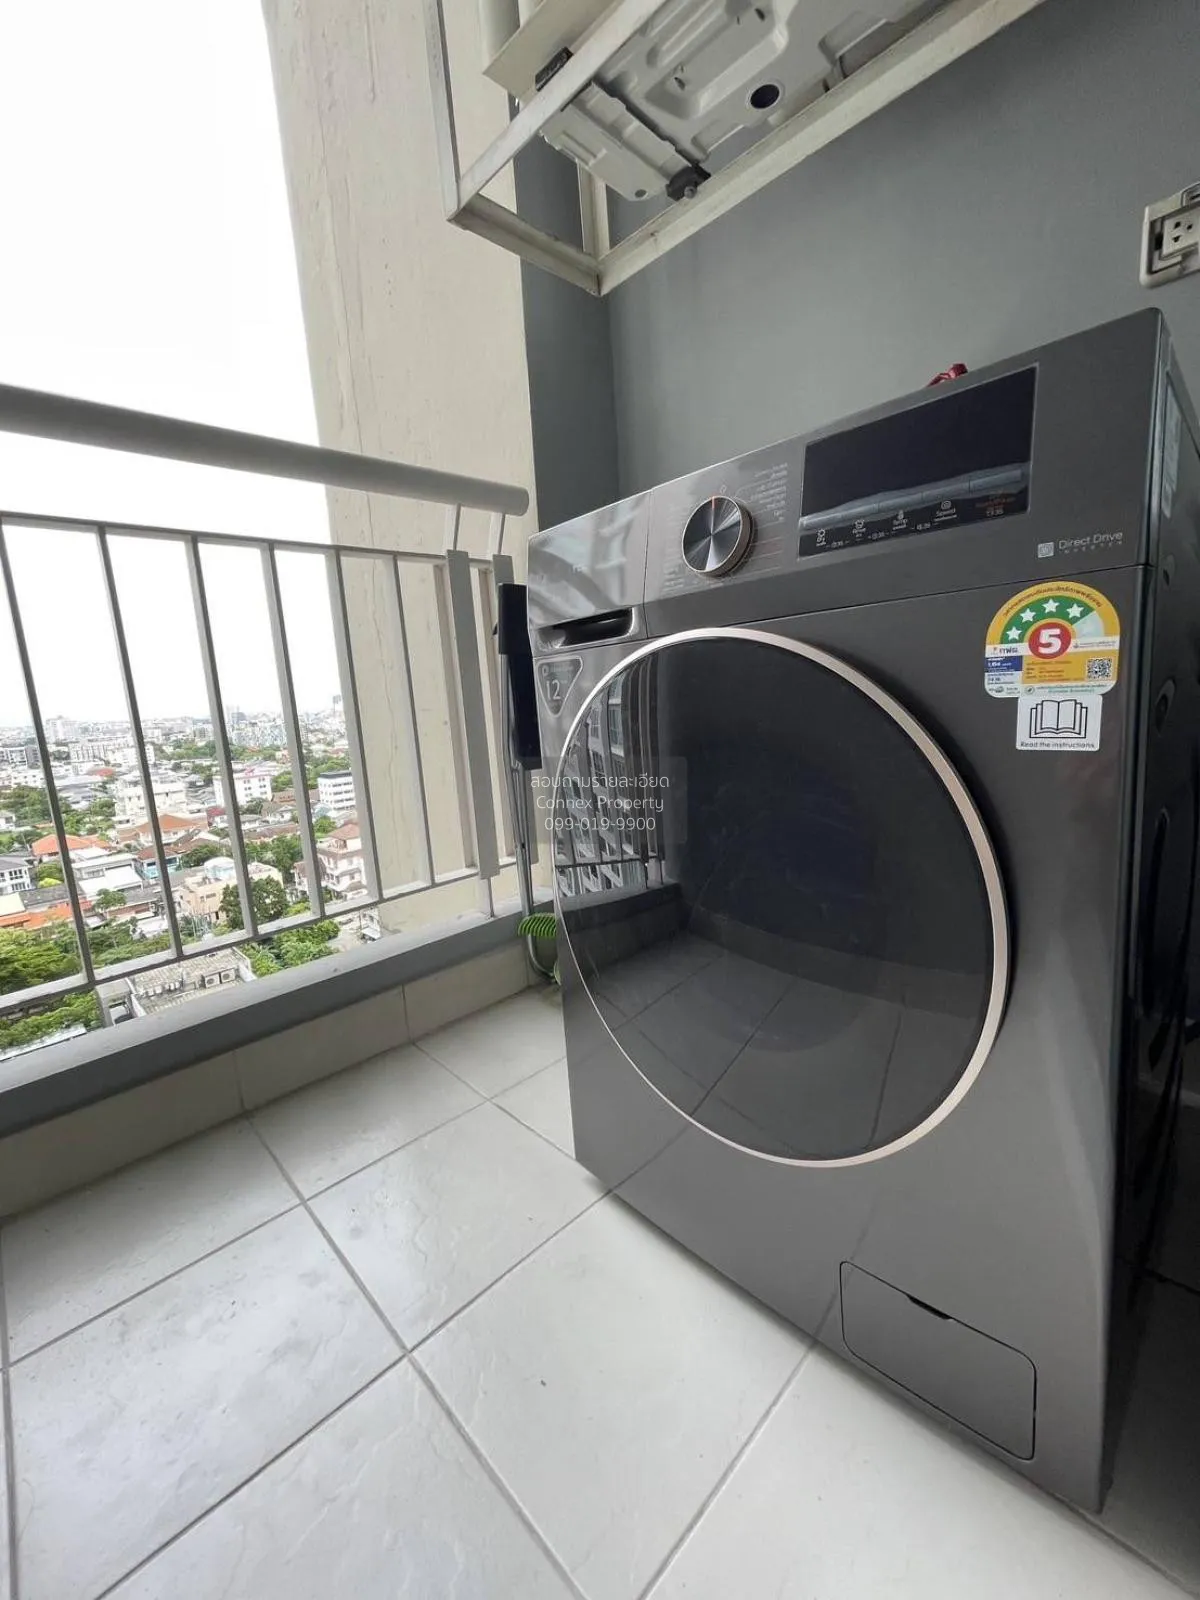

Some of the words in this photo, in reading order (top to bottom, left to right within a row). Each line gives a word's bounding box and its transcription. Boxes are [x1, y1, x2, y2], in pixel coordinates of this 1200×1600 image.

[1058, 536, 1091, 549] Direct
[1093, 532, 1123, 543] Drive
[1038, 628, 1062, 655] 5
[546, 679, 561, 701] 12
